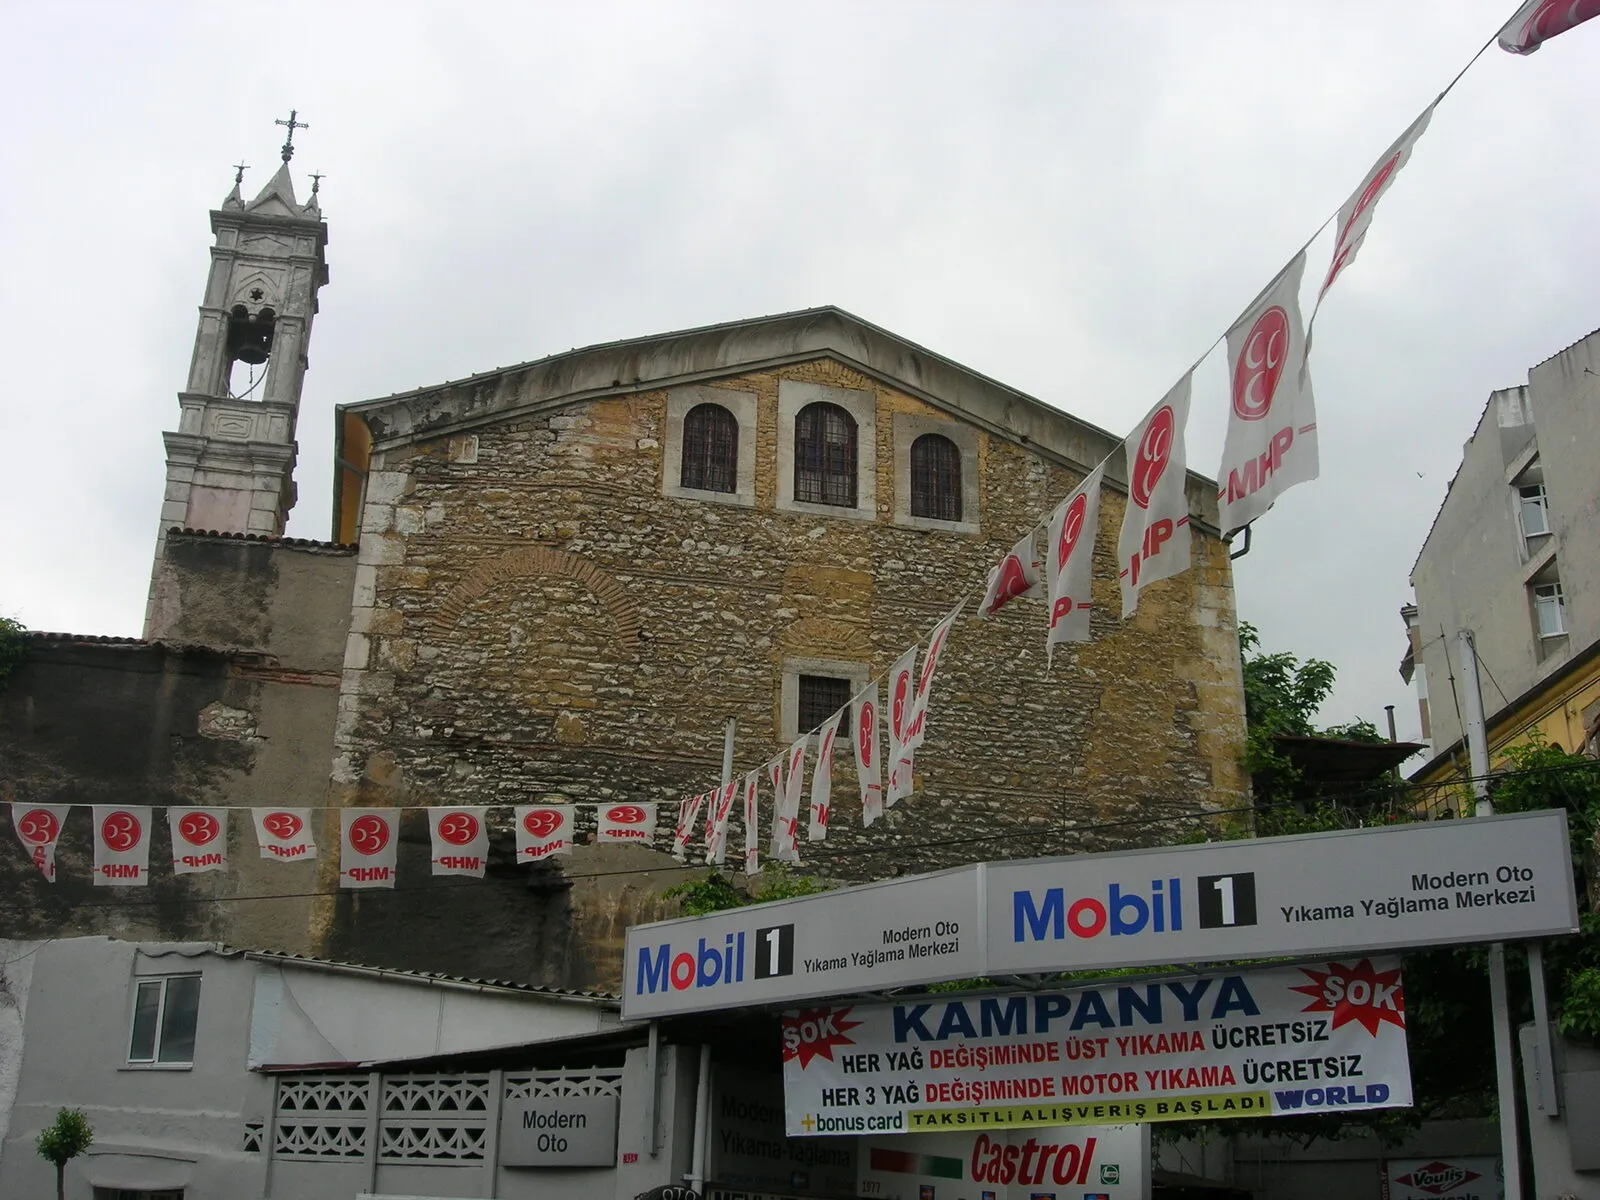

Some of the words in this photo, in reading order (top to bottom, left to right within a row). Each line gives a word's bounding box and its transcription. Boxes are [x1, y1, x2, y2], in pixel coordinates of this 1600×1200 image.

[1227, 426, 1294, 505] MHP
[1411, 869, 1490, 892] Modern
[1495, 866, 1534, 882] Oto
[1014, 878, 1182, 943] Mobil
[1213, 876, 1235, 925] 1
[1281, 904, 1355, 925] Yıkama
[1359, 897, 1451, 919] Yağlama
[1455, 886, 1536, 910] Merkezi
[883, 926, 931, 945] Modern
[935, 921, 959, 937] Oto
[636, 931, 745, 995] Mobil
[765, 928, 781, 975] 1
[804, 957, 848, 973] Yıkama
[851, 949, 905, 969] Yağlama
[909, 939, 959, 959] Merkezi
[893, 976, 1260, 1043] KAMPANYA
[1323, 976, 1400, 1010] ŞOK
[783, 1015, 840, 1053] ŞOK
[842, 1053, 880, 1073] HER
[885, 1047, 924, 1071] YAĞ
[1065, 1036, 1109, 1060] ÜST
[1116, 1031, 1206, 1057] YIKAMA
[822, 1087, 861, 1108] HER
[865, 1086, 876, 1106] 3
[881, 1080, 919, 1103] YAĞ
[1062, 1071, 1138, 1096] MOTOR
[1145, 1065, 1236, 1091] YIKAMA
[1274, 1083, 1390, 1110] WORLD
[523, 1110, 586, 1129] Modern
[868, 1110, 902, 1130] card
[1157, 1096, 1265, 1116] BAŞLADI
[537, 1134, 568, 1153] Oto
[971, 1133, 1097, 1186] Castrol
[862, 1180, 881, 1194] 1977
[1413, 1169, 1464, 1187] Voulis
